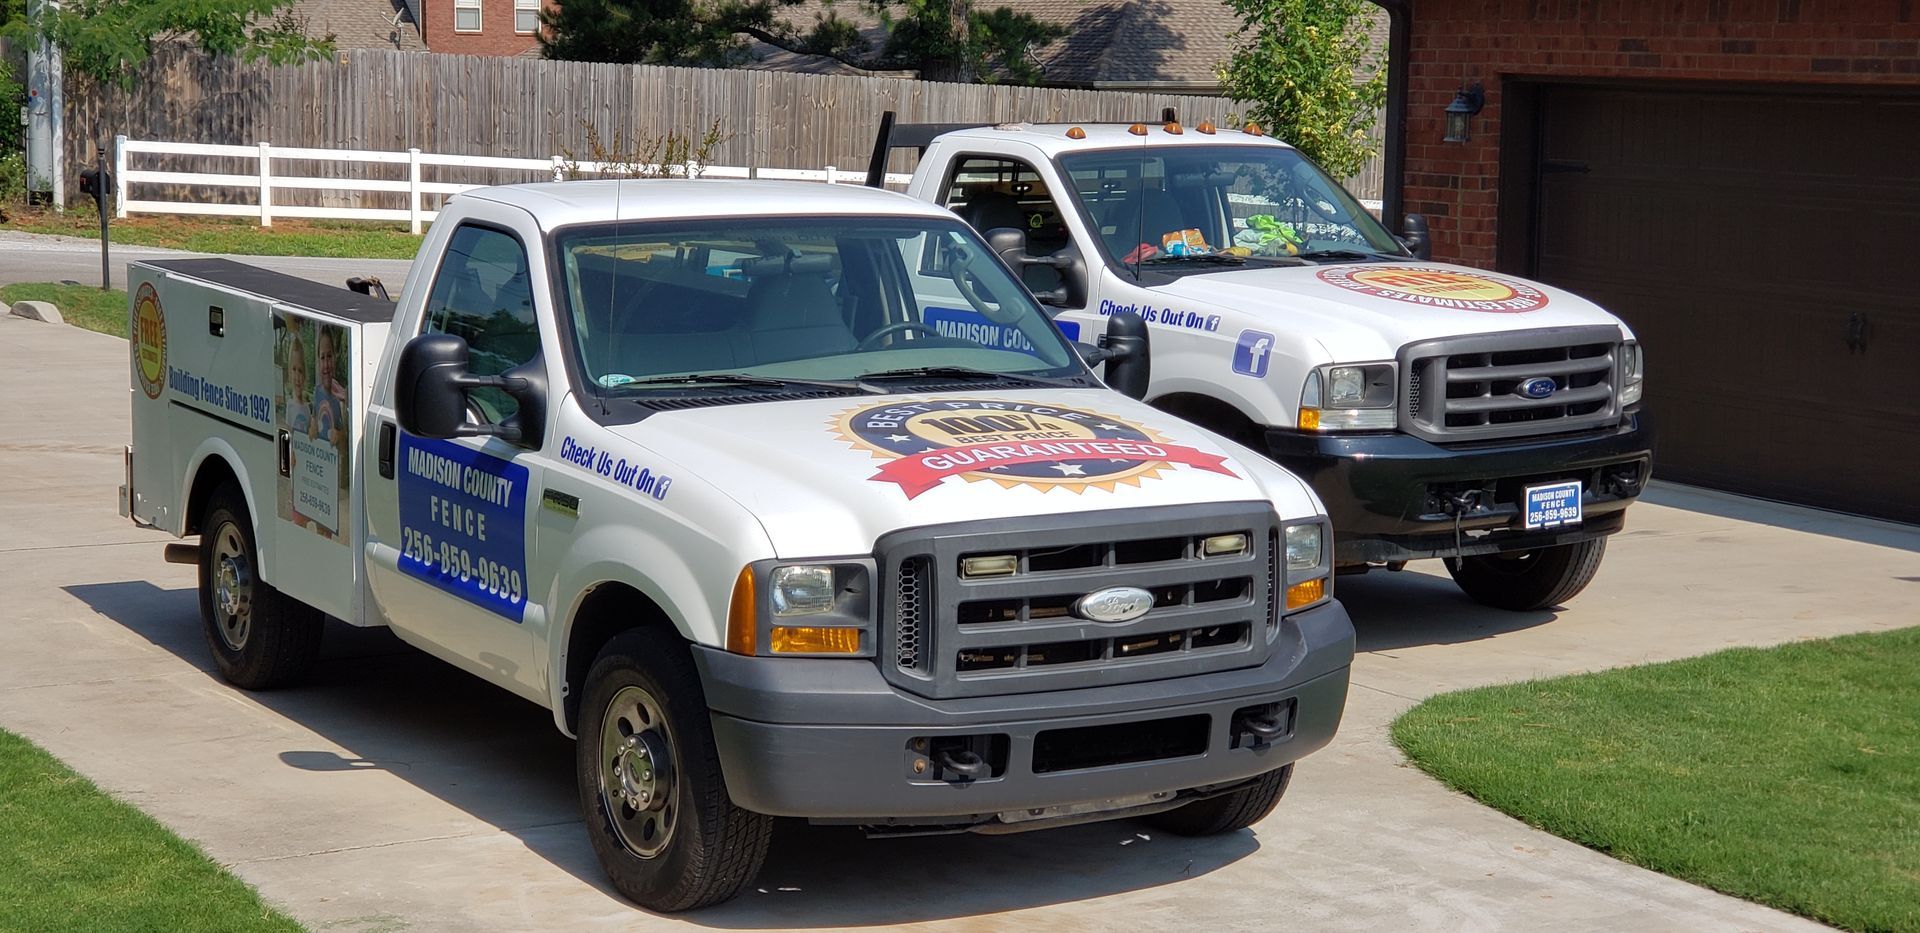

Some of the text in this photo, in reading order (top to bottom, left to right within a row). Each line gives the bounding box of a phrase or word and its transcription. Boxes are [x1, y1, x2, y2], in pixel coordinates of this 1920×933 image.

[1375, 288, 1506, 310] ESTIMATES
[1141, 304, 1157, 321] Us
[1160, 307, 1184, 327] Out
[1185, 311, 1204, 329] On
[140, 315, 160, 350] FREE
[935, 319, 1034, 351] MADISON COU
[168, 364, 200, 401] Building
[200, 376, 224, 408] Fence
[224, 385, 248, 417] Since
[249, 392, 271, 424] 1992
[866, 401, 1092, 429] BEST PRICE
[918, 413, 1060, 436] 100%
[952, 430, 1080, 444] BEST PRICE
[305, 460, 324, 478] FENCE
[560, 435, 597, 470] Check
[596, 450, 613, 477] Us
[613, 458, 639, 487] Out
[635, 467, 656, 495] On
[921, 440, 1168, 471] GUARANTEED
[407, 446, 462, 491] MADISON
[463, 465, 514, 509] COUNTY
[1532, 489, 1575, 502] MADISON COUNTY
[1542, 500, 1566, 510] FENCE
[430, 495, 486, 542] FENCE
[1530, 507, 1577, 522] 256-859-9639
[403, 526, 522, 605] 256-859-9639
